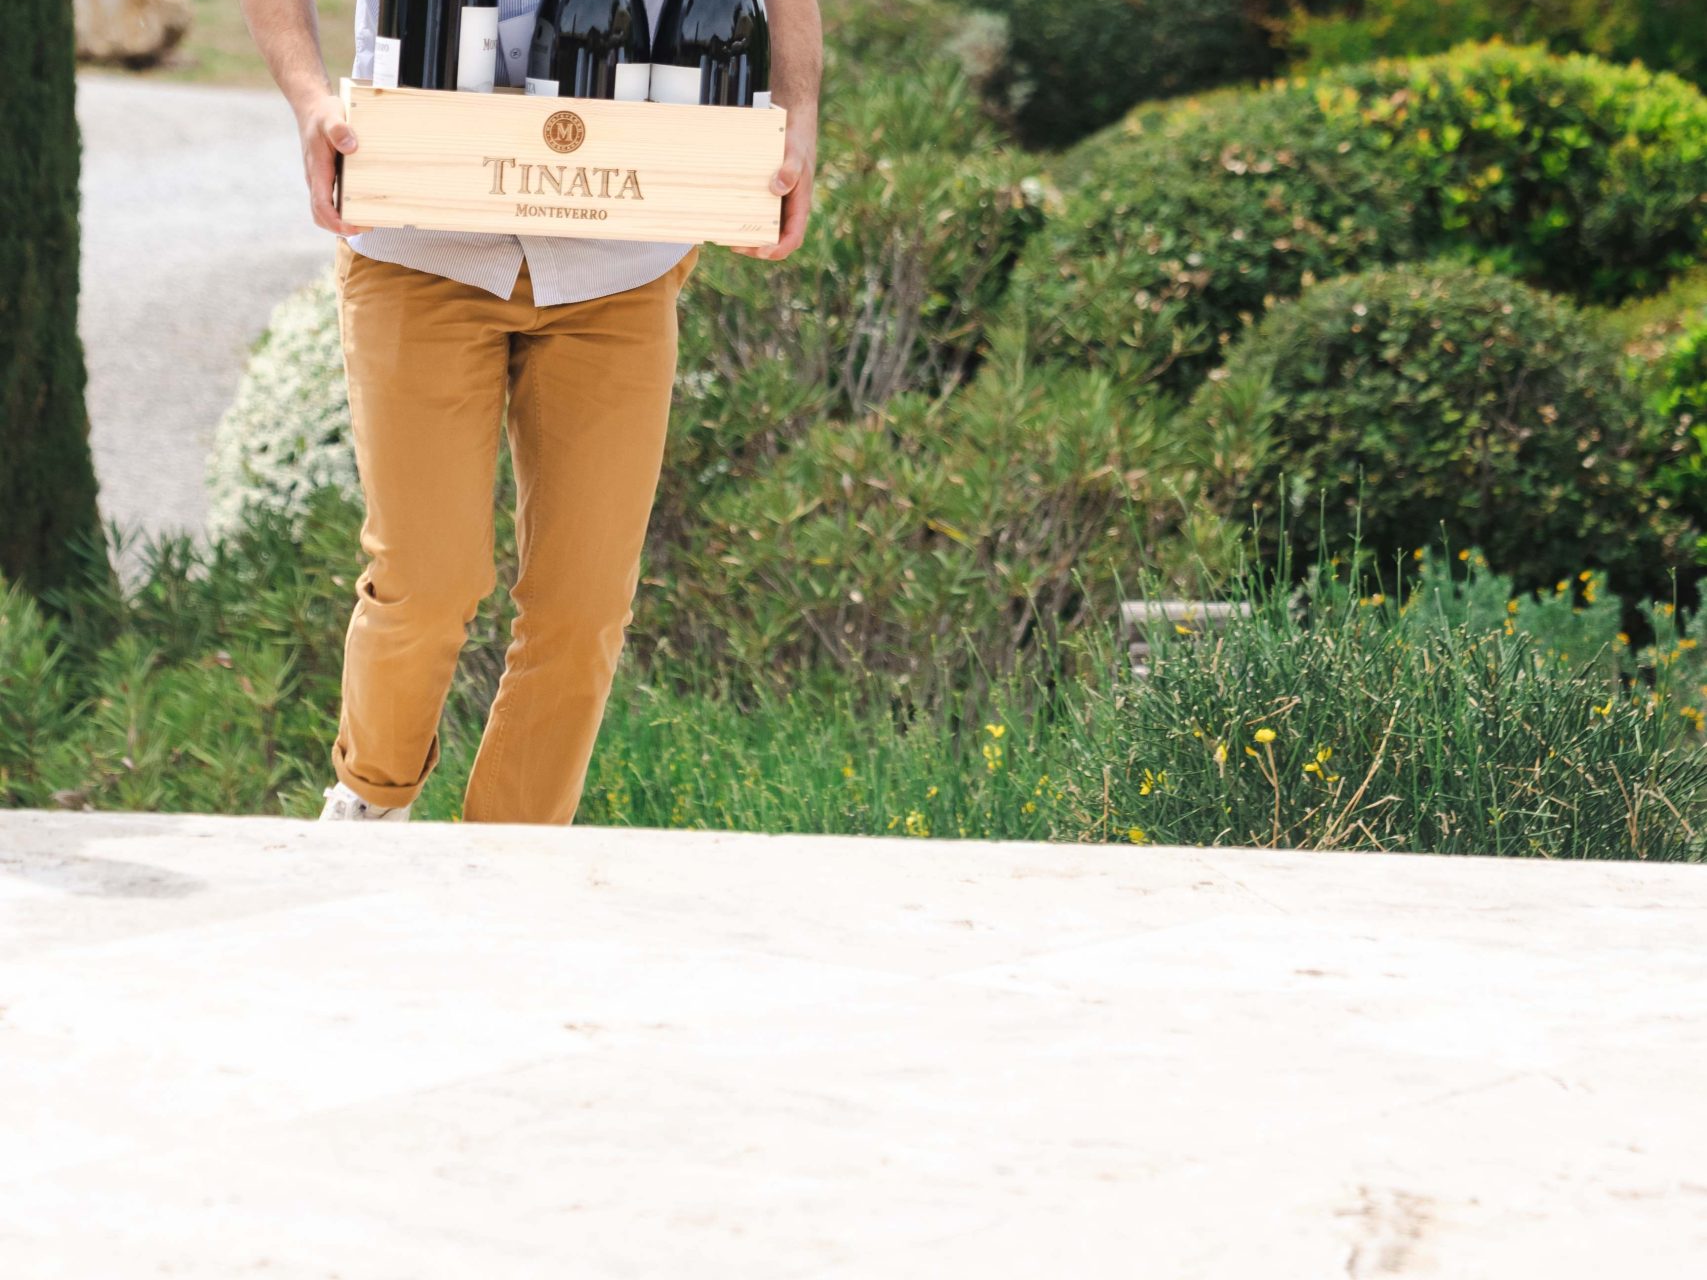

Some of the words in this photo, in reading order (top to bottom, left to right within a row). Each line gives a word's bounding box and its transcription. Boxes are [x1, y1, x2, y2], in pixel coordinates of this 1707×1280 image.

[554, 122, 574, 141] M
[482, 156, 644, 200] TINATA
[515, 203, 608, 220] MONTEVERRO
